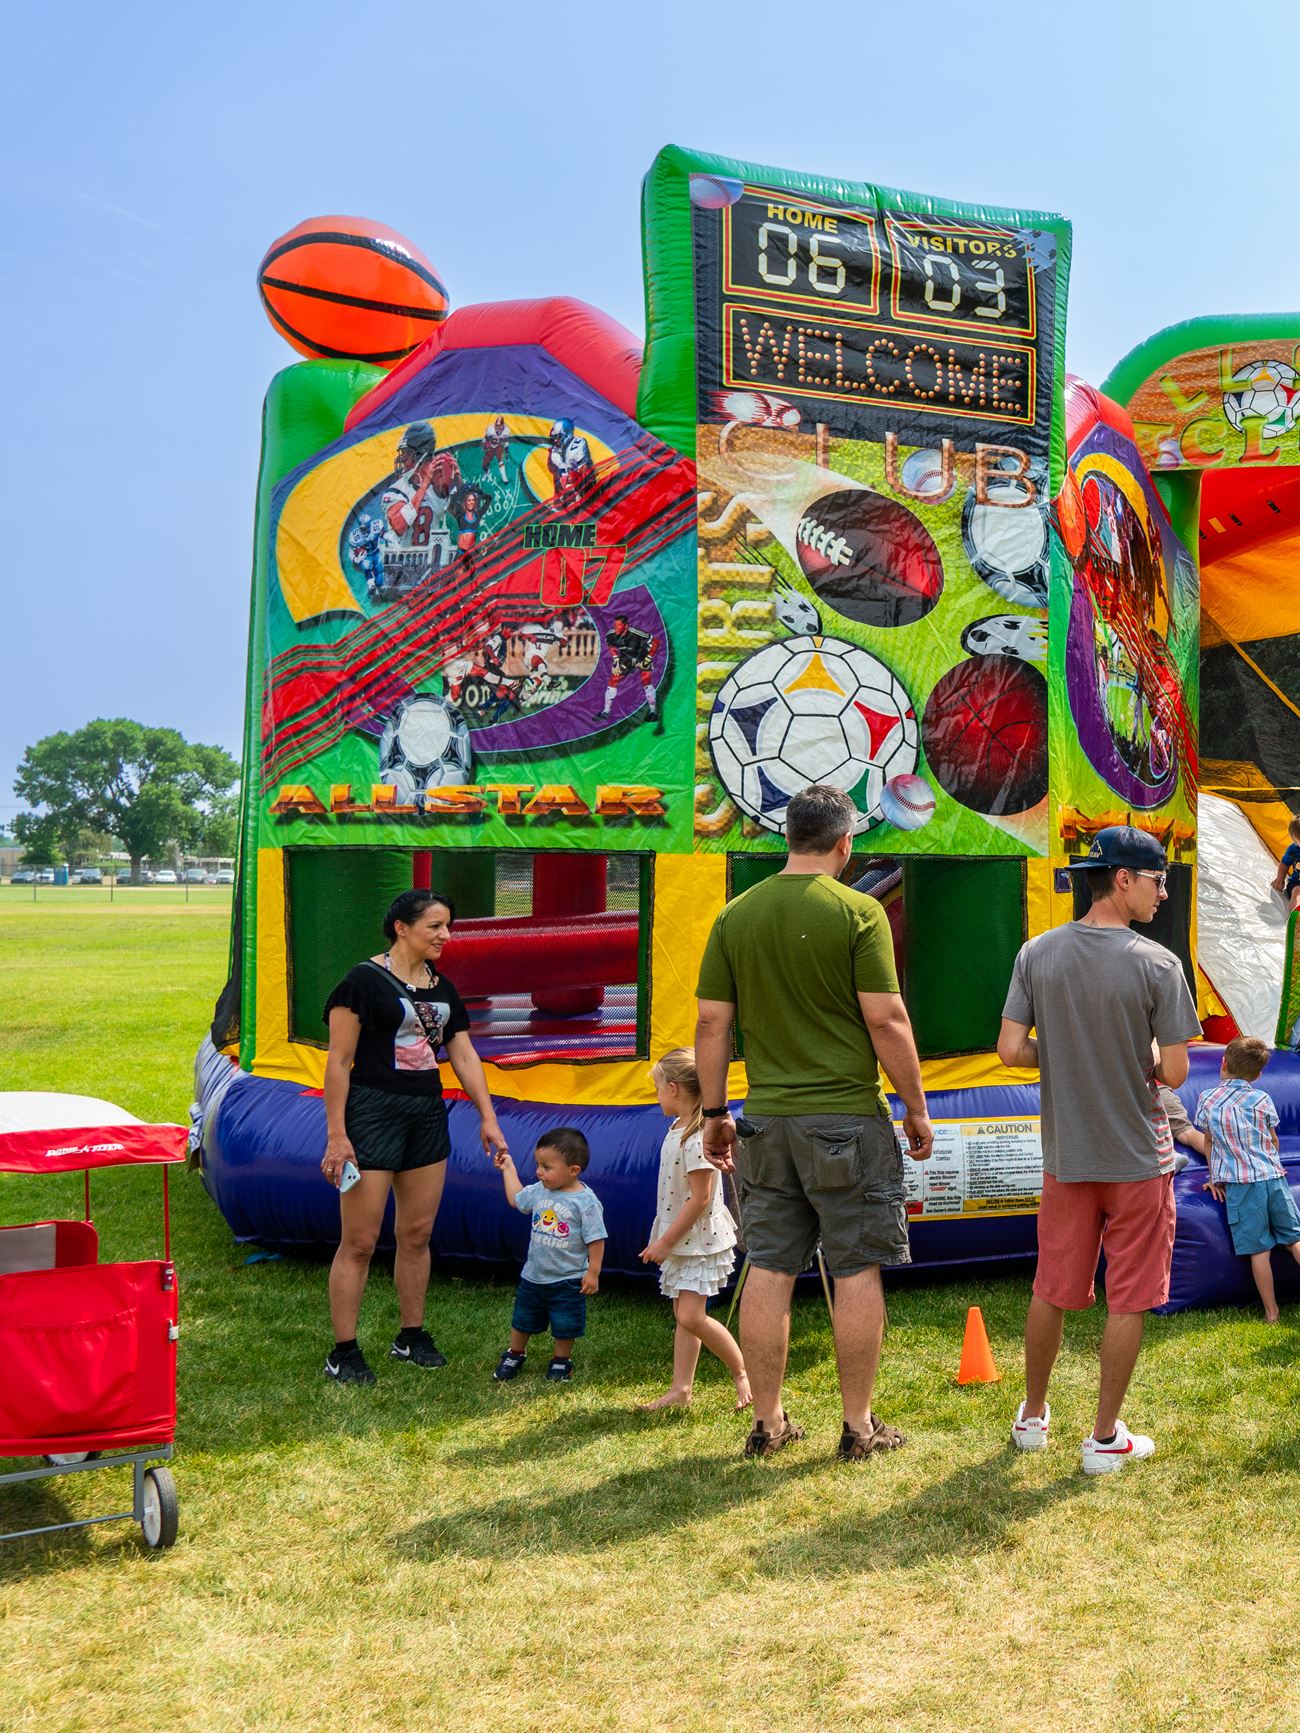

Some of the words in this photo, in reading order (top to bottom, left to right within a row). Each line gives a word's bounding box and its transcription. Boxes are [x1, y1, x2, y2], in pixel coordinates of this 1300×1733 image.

[767, 204, 838, 234] HOME
[757, 222, 846, 294] 06
[906, 234, 1018, 259] VISITORS
[922, 254, 1007, 318] 03
[739, 318, 1022, 411] WELCOME
[523, 522, 597, 550] HOME
[540, 544, 628, 608] 07
[694, 490, 777, 840] SRTS
[267, 784, 418, 815] ALL
[424, 784, 667, 815] STAR
[986, 1124, 1032, 1135] CAUTION
